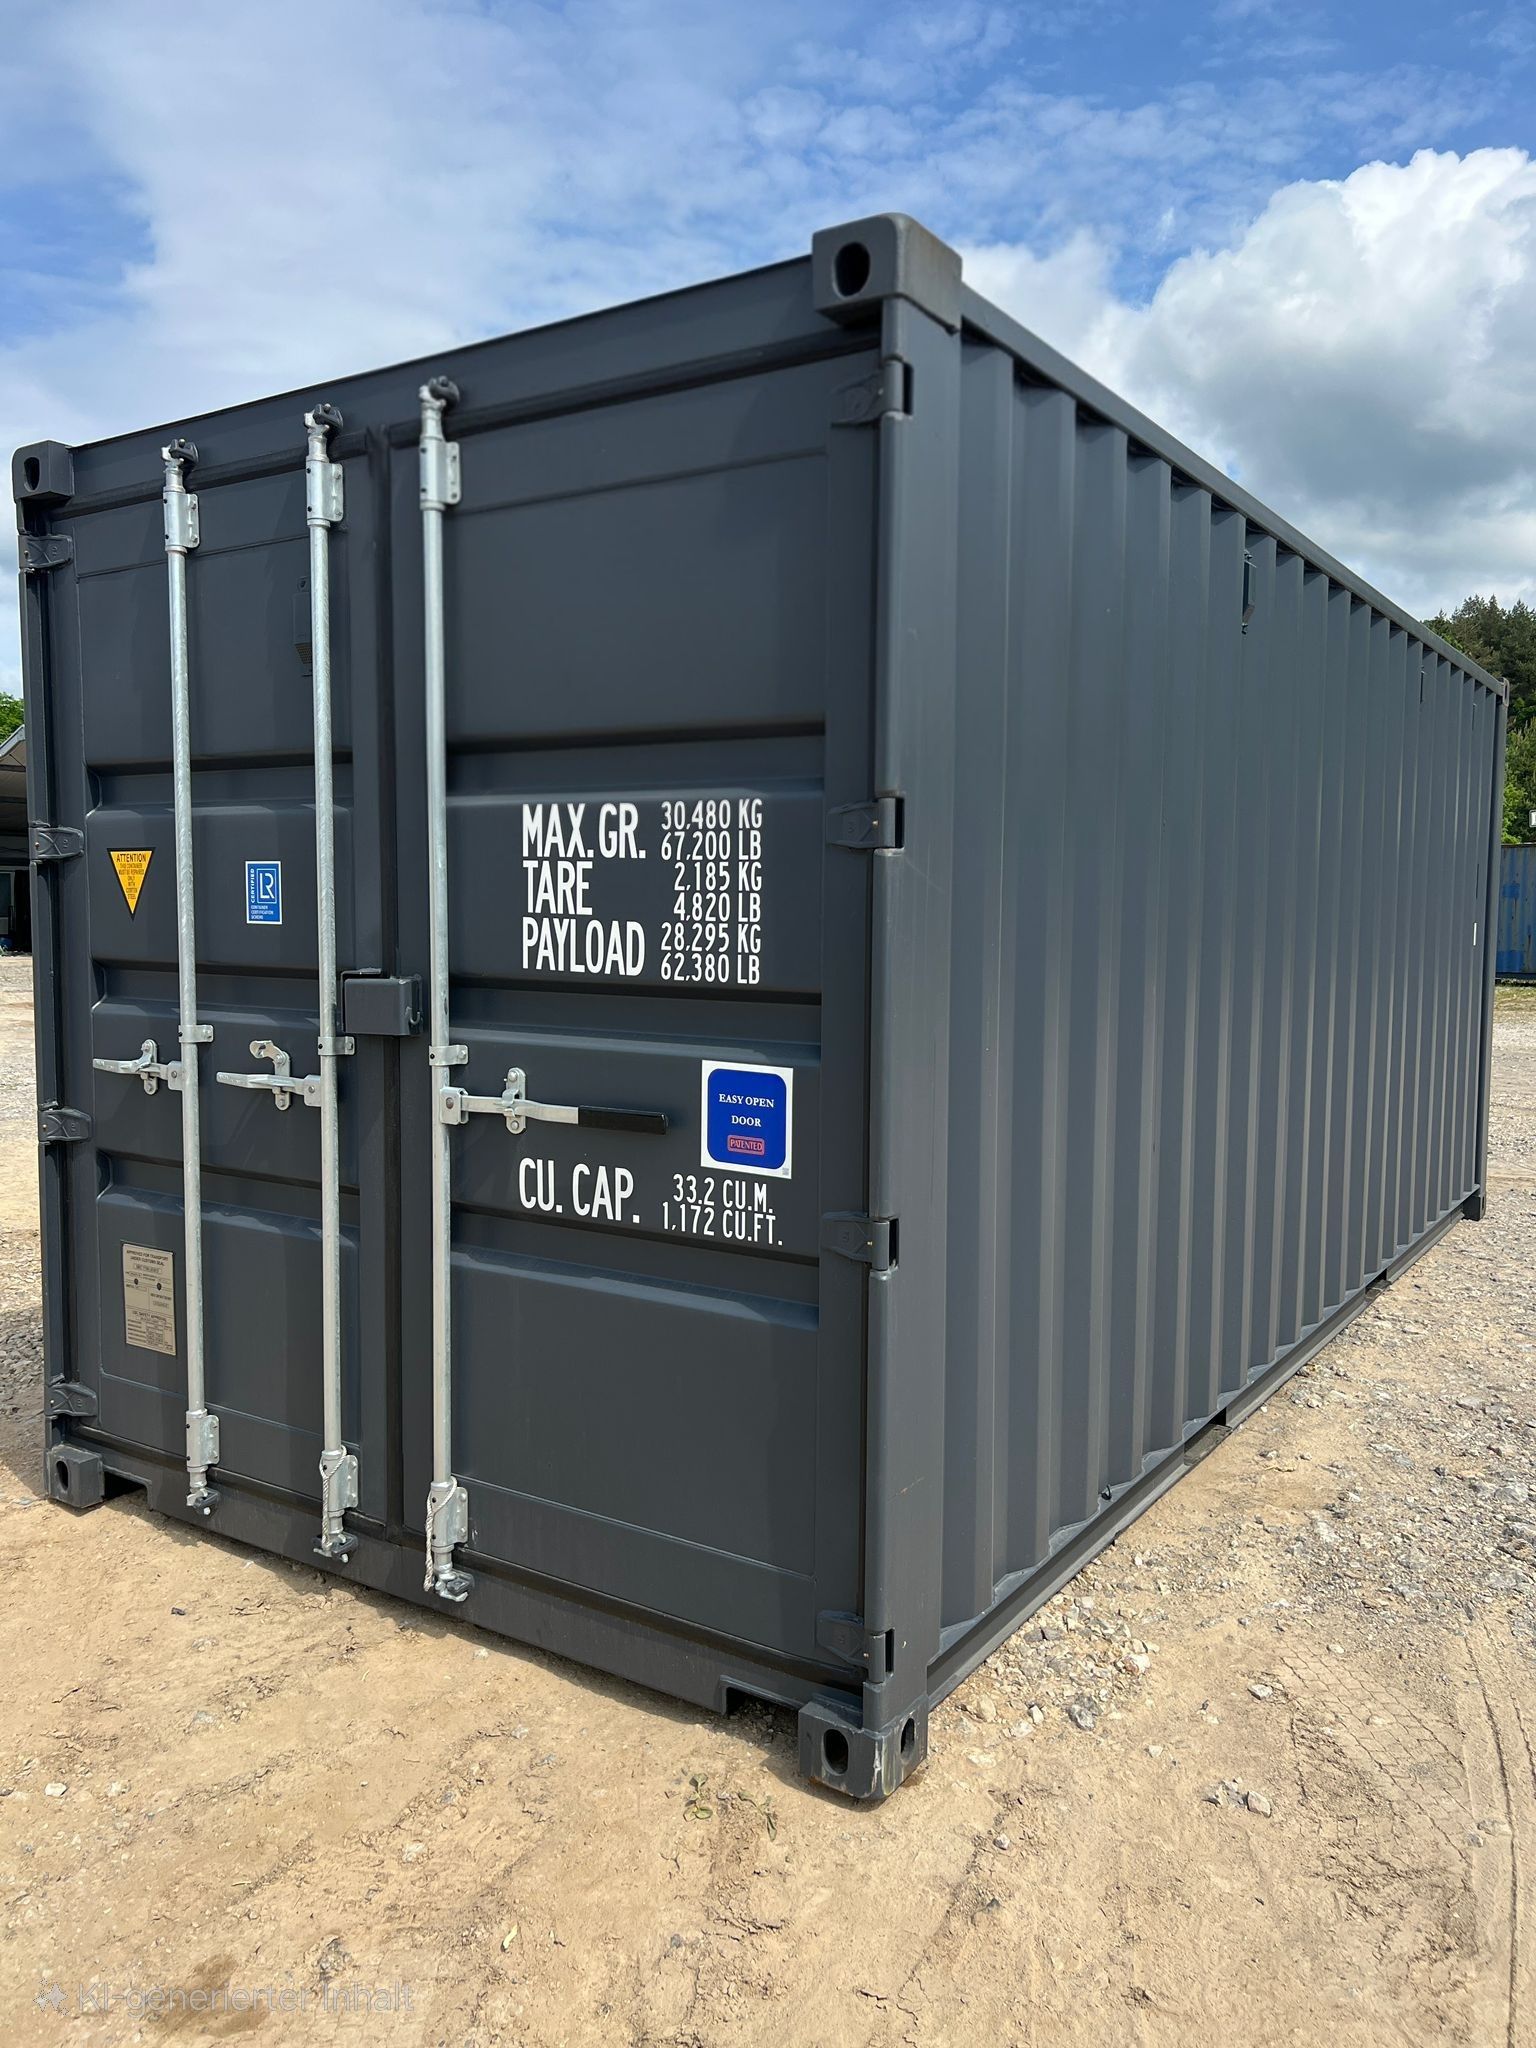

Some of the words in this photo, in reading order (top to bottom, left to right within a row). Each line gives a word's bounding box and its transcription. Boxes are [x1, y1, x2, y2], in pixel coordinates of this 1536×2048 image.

[661, 799, 731, 831] 30,480
[738, 798, 763, 829] KG
[116, 853, 146, 863] ATTENTION
[661, 830, 731, 861] 67,200
[738, 829, 762, 861] LB
[260, 872, 275, 899] LR
[522, 859, 593, 916] TARE
[674, 861, 731, 892] 2,185
[738, 861, 762, 892] KG
[673, 892, 731, 922] 4,820
[737, 892, 761, 923] LB
[522, 916, 646, 977] PAYLOAD
[660, 922, 731, 953] 28,295
[737, 923, 762, 954] KG
[660, 952, 730, 983] 62,380
[737, 954, 760, 985] LB
[718, 1093, 744, 1105] EASY
[745, 1096, 775, 1108] OPEN
[731, 1115, 762, 1128] DOOR
[730, 1138, 763, 1152] PATENTED
[518, 1157, 563, 1214] CU.
[572, 1163, 640, 1224] CAP.
[673, 1173, 715, 1207] 33.2
[662, 1201, 715, 1236] 1,172
